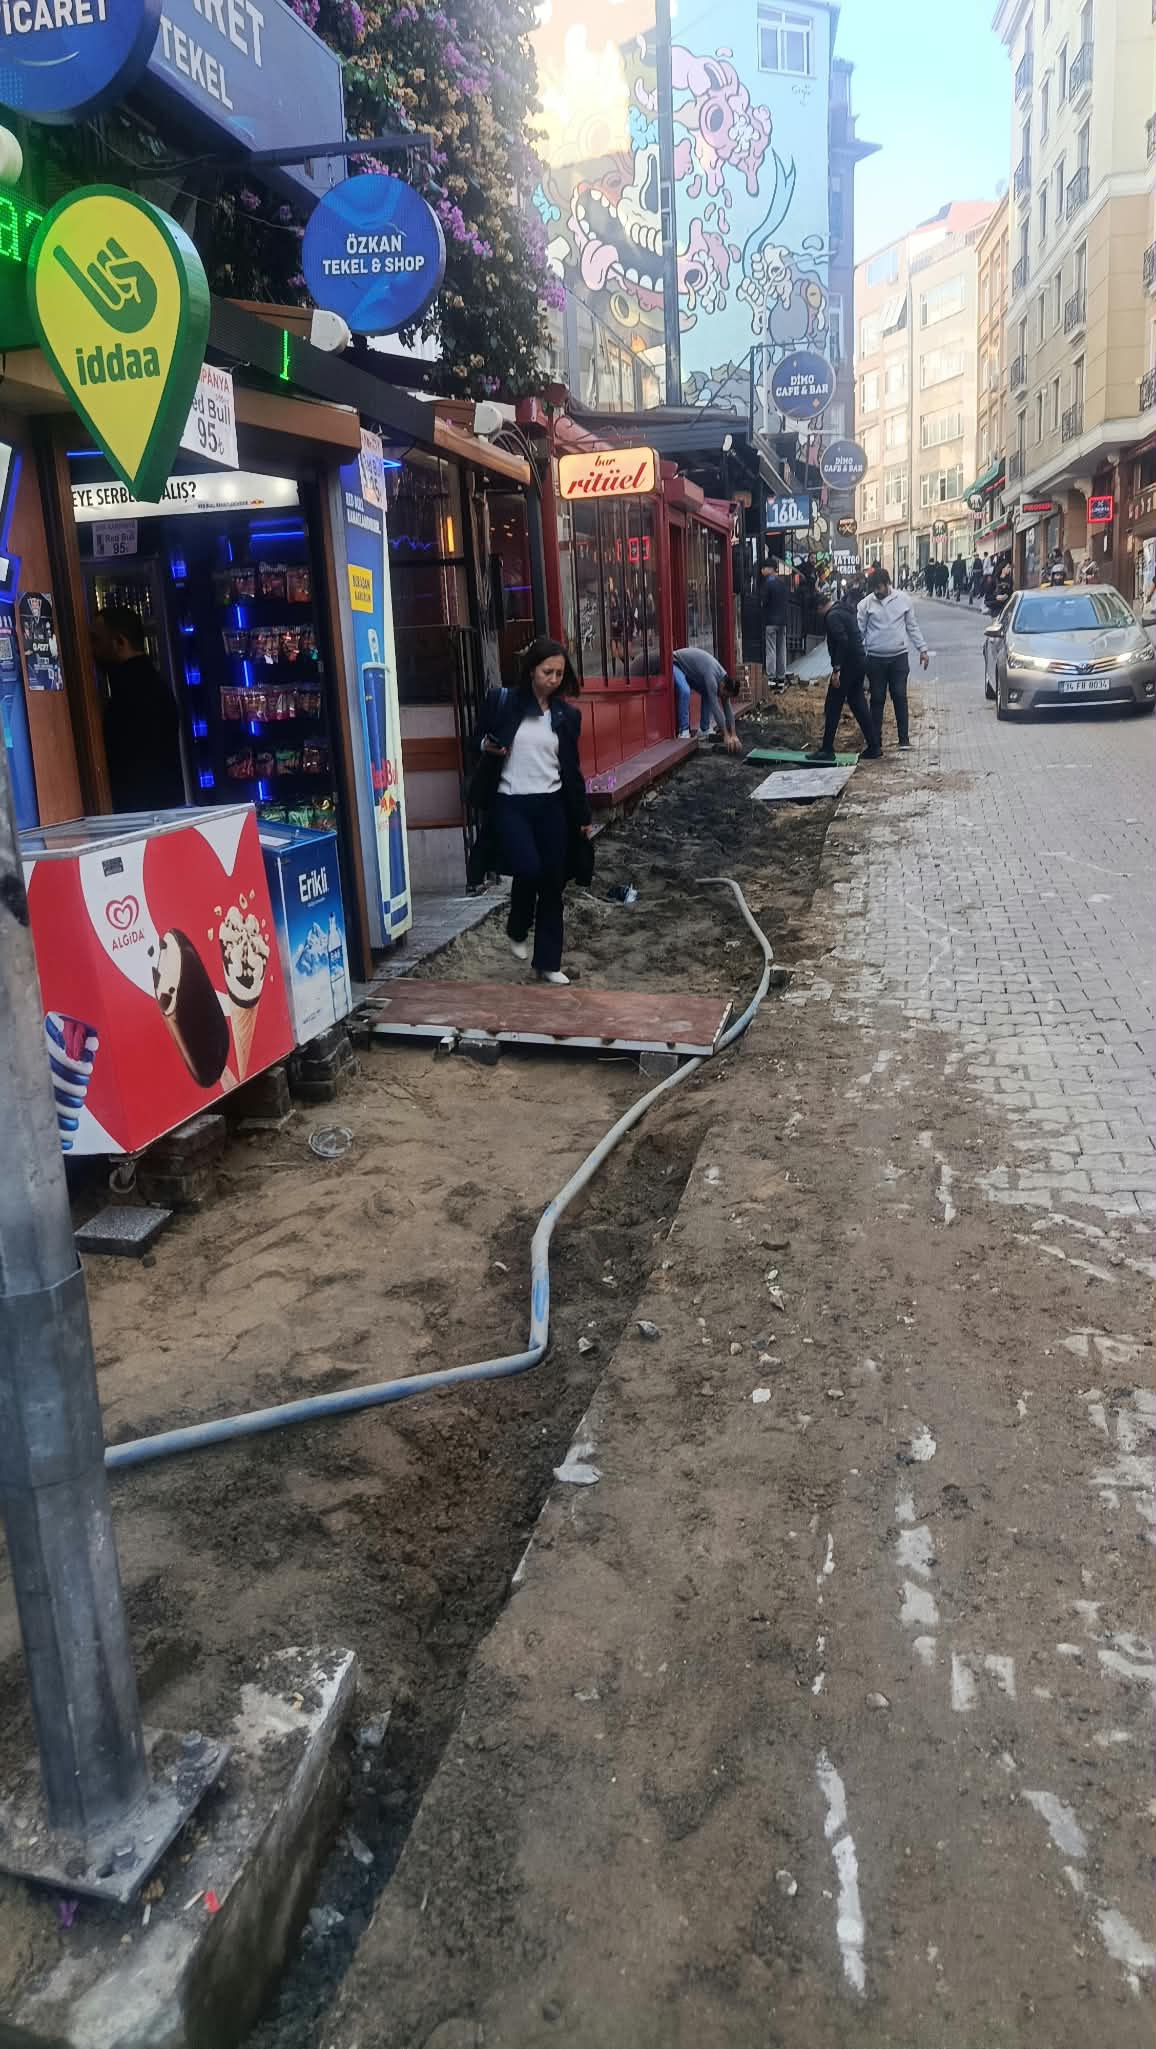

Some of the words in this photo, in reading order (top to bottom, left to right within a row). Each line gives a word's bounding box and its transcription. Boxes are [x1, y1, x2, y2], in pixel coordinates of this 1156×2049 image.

[0, 0, 107, 34] İCARET
[160, 15, 233, 111] TEKEL
[346, 233, 402, 254] ÖZKAN
[322, 258, 368, 275] TEKEL
[371, 259, 382, 272] &
[385, 255, 424, 273] SHOP
[75, 343, 160, 386] iddaa
[201, 367, 230, 393] PANYA
[776, 385, 799, 398] CAFE
[809, 383, 829, 395] BAR
[791, 373, 814, 386] DİMO
[193, 393, 205, 415] ed
[208, 398, 231, 425] Bull
[595, 455, 616, 467] bar
[567, 462, 648, 495] ritüel
[298, 866, 328, 903] Erikli
